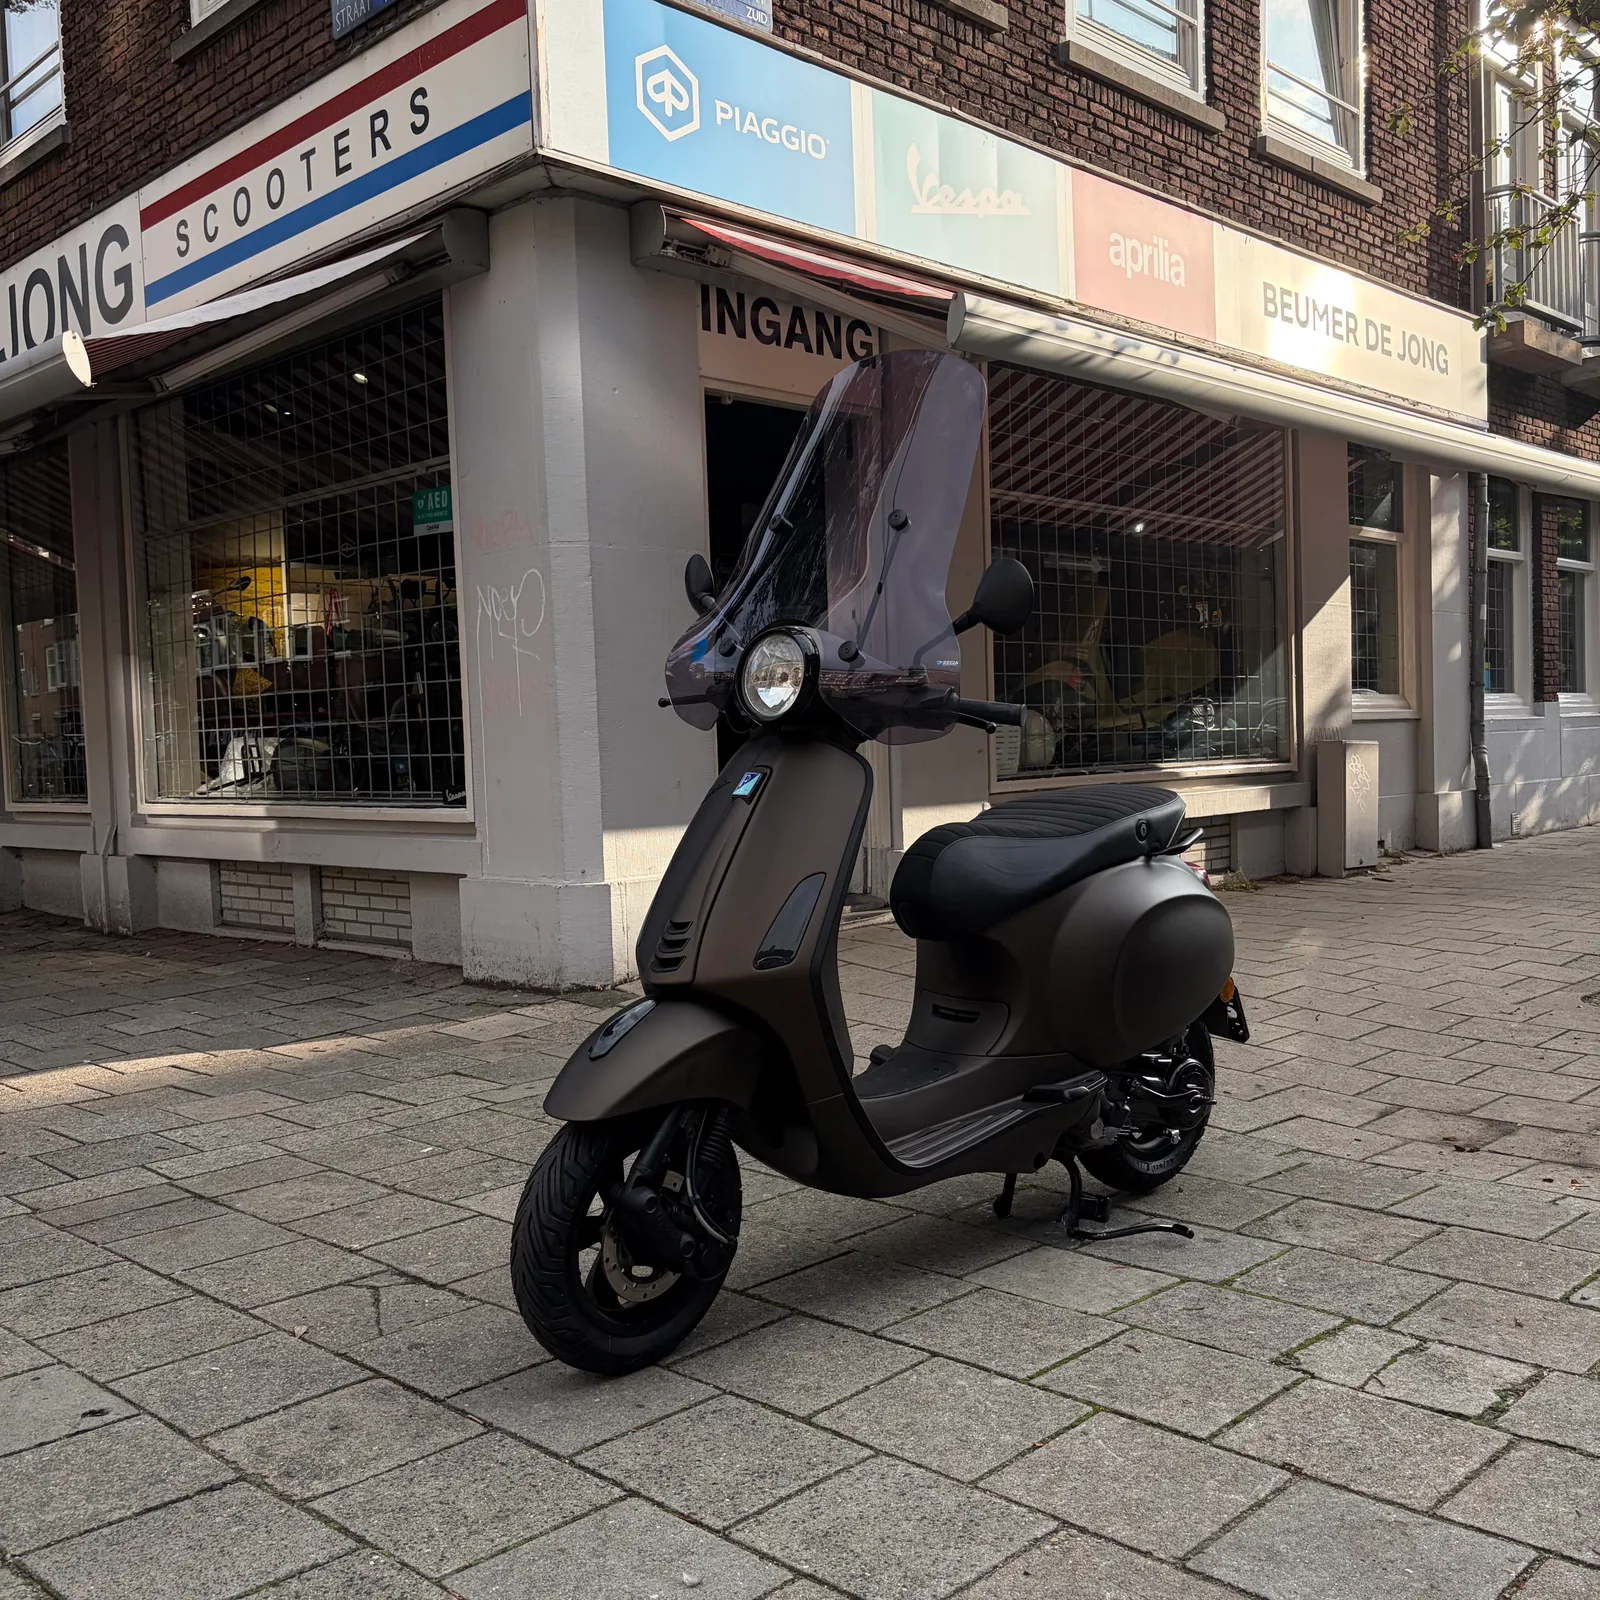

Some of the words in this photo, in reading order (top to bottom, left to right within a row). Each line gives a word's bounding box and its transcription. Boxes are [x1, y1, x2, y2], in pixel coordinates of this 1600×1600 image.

[746, 6, 768, 24] ZUID
[714, 99, 827, 160] PIAGGIO
[176, 86, 430, 258] SCOOTERS
[906, 142, 1032, 219] Vespa
[0, 223, 134, 361] JONG
[1108, 232, 1186, 288] aprilia
[700, 283, 875, 370] INGANG
[1262, 281, 1360, 347] BEUMER
[1365, 318, 1392, 358] DE
[1397, 330, 1449, 376] JONG
[427, 490, 448, 510] AED
